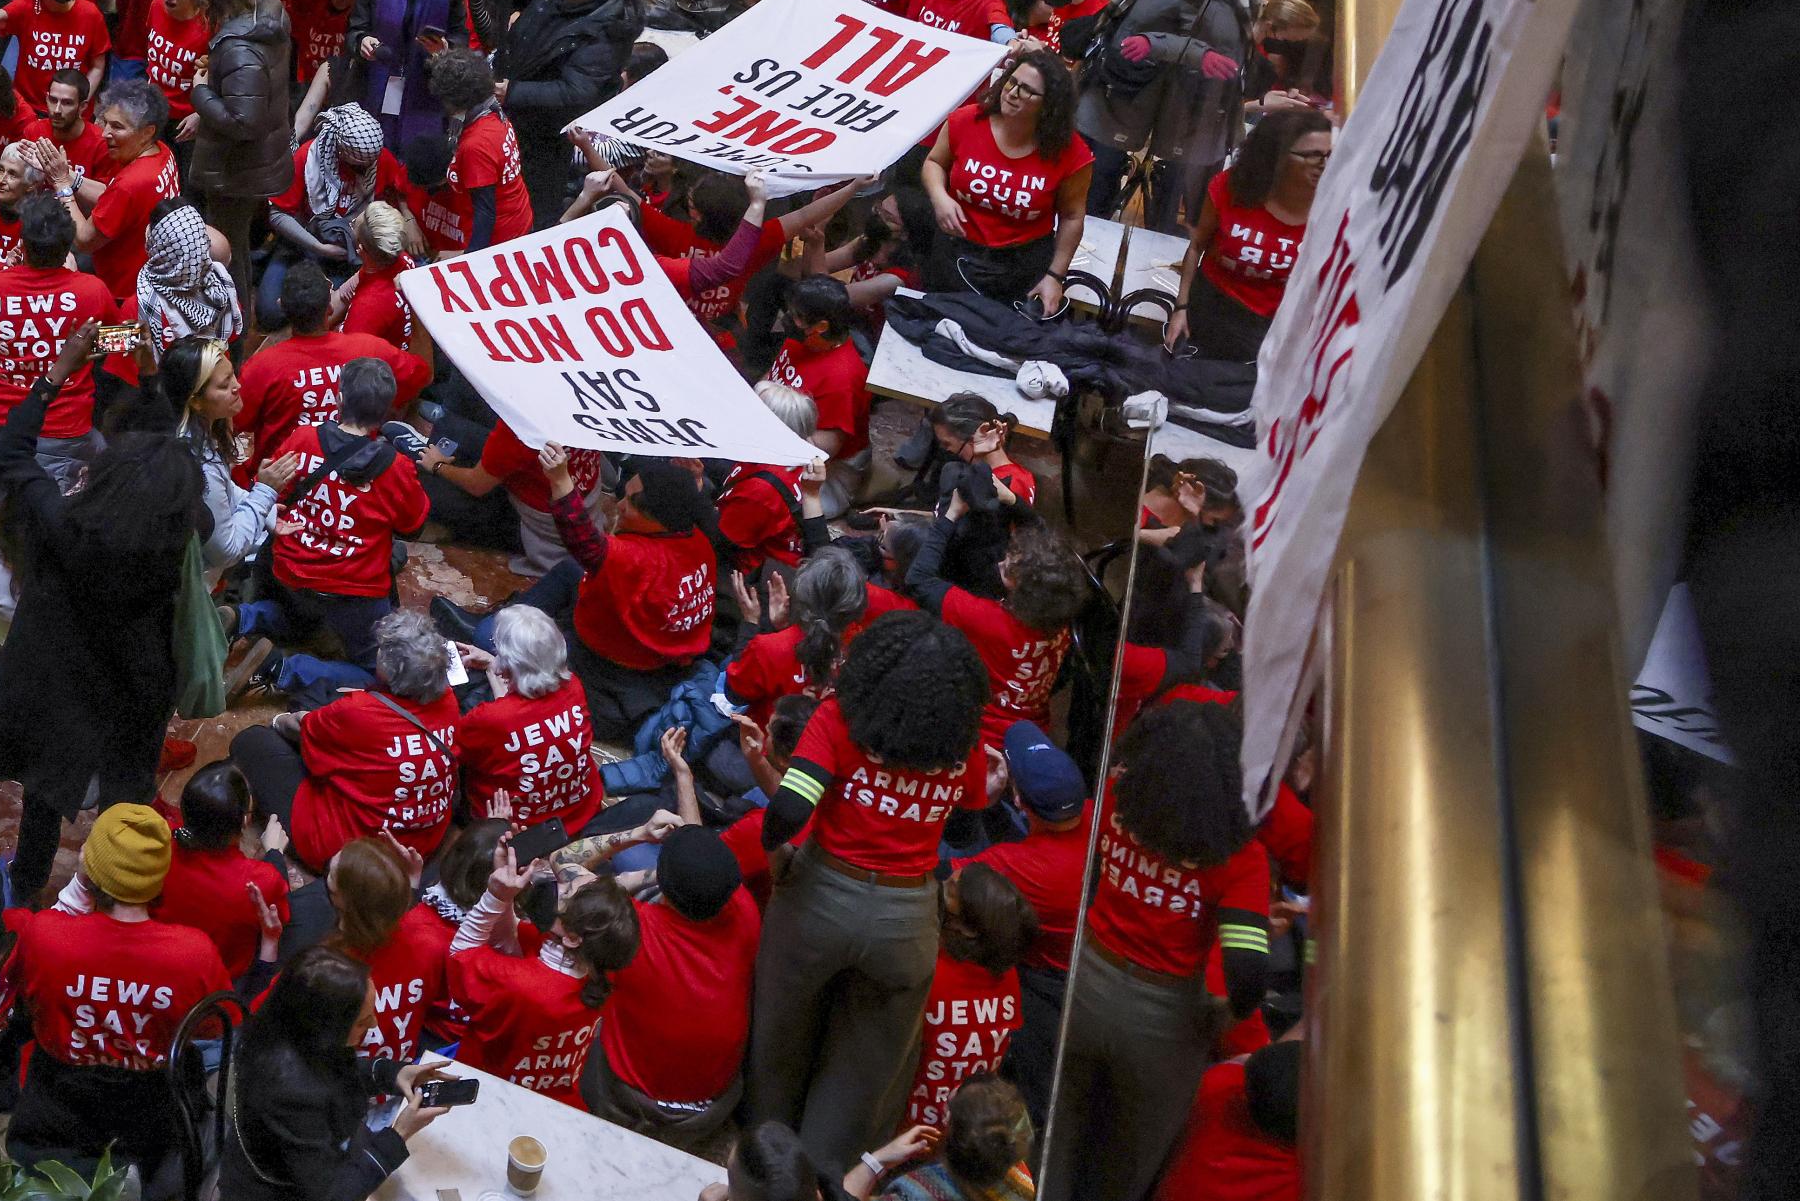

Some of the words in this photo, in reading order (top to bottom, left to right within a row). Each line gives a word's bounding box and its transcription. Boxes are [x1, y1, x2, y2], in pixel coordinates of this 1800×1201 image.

[32, 31, 62, 46] NOT
[68, 32, 86, 46] IN
[34, 44, 77, 61] OUR
[176, 47, 197, 63] IN
[799, 13, 951, 98] ALL
[147, 47, 184, 76] OUR
[733, 58, 803, 98] US
[610, 106, 701, 147] FOR
[692, 84, 838, 156] ONE,
[787, 84, 900, 134] FACE
[964, 158, 1013, 185] NOT
[1021, 175, 1046, 191] IN
[968, 178, 1031, 208] OUR
[428, 227, 646, 314] COMPLY
[469, 314, 586, 365] NOT
[584, 297, 675, 360] DO
[293, 364, 343, 388] JEW
[561, 367, 662, 414] SAY
[302, 388, 344, 409] SA
[572, 413, 719, 450] JEWS
[307, 482, 358, 512] AY
[386, 725, 456, 758] JEWS
[504, 705, 585, 753] JEWS
[519, 733, 584, 775] SAY
[518, 755, 588, 813] STOP
[851, 767, 964, 802] ARMING
[65, 974, 174, 1010] JEWS
[75, 1004, 154, 1035] SAY
[925, 994, 1016, 1026] JEWS
[70, 1029, 152, 1056] STOP
[360, 1011, 414, 1046] AY
[935, 1027, 1010, 1058] SAY
